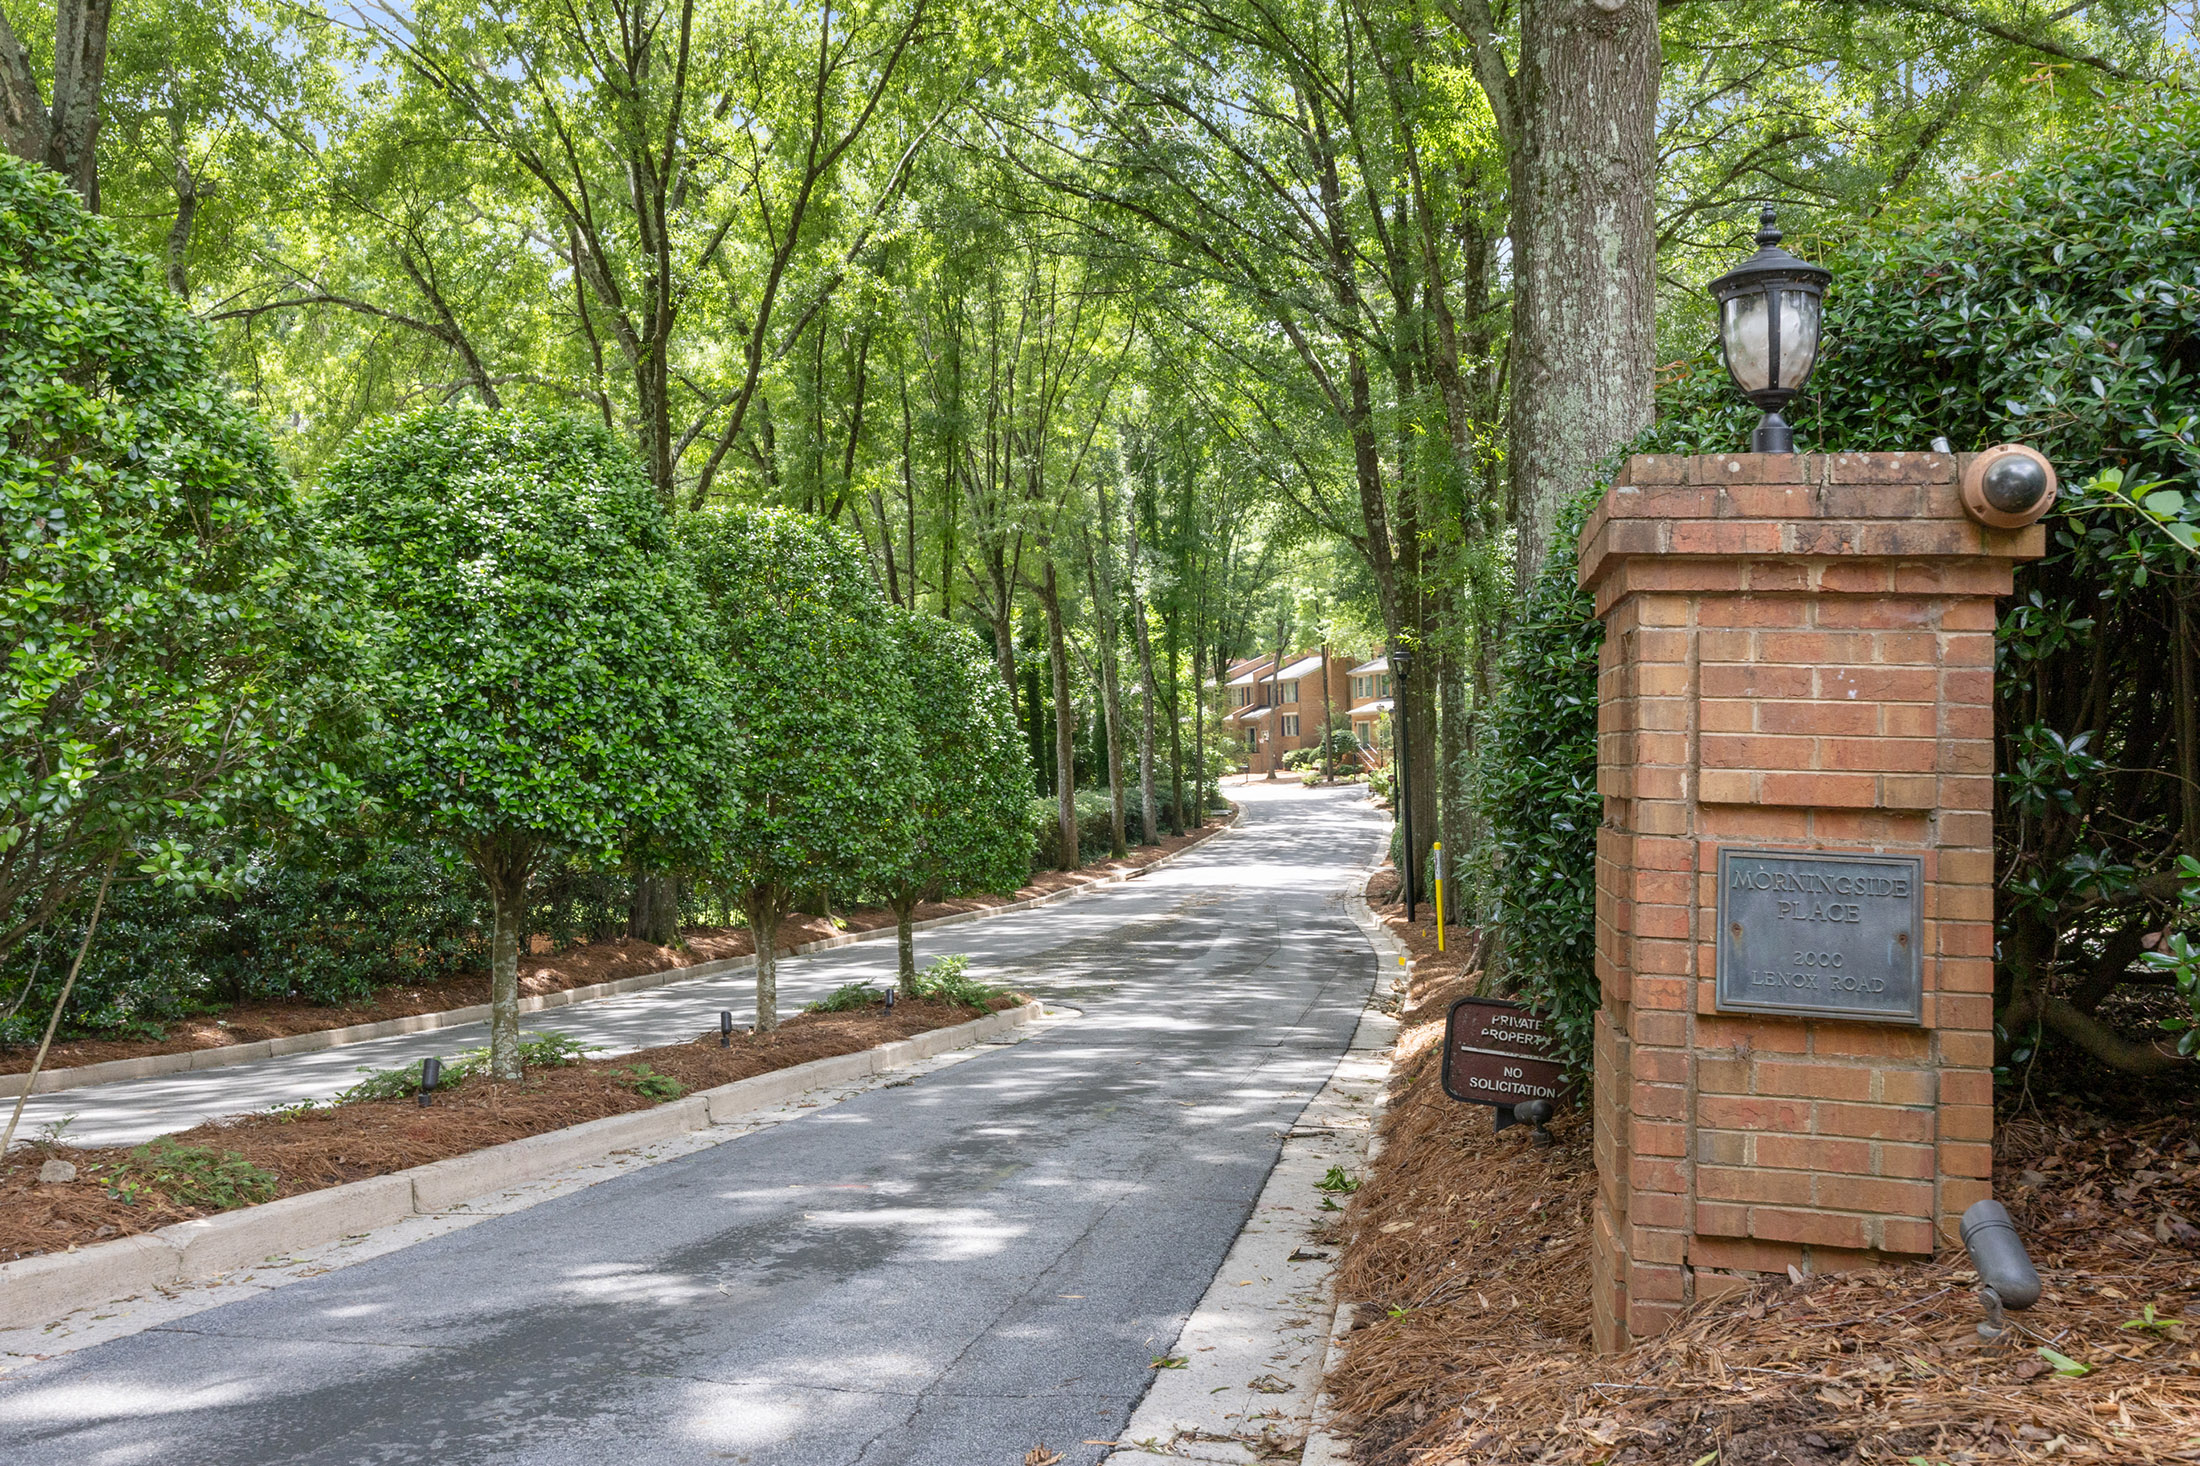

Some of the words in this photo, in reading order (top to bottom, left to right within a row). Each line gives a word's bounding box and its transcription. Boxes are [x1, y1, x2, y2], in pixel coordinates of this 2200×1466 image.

[1732, 870, 1909, 897] MORNINGSIDE
[1777, 900, 1861, 923] PLACE
[1794, 951, 1843, 968] 2000
[1752, 971, 1818, 988] LENOX
[1830, 976, 1885, 993] ROAD
[1491, 1015, 1544, 1030] PRIVATE
[1503, 1067, 1523, 1078] NO
[1469, 1077, 1555, 1098] SOLICITATION
